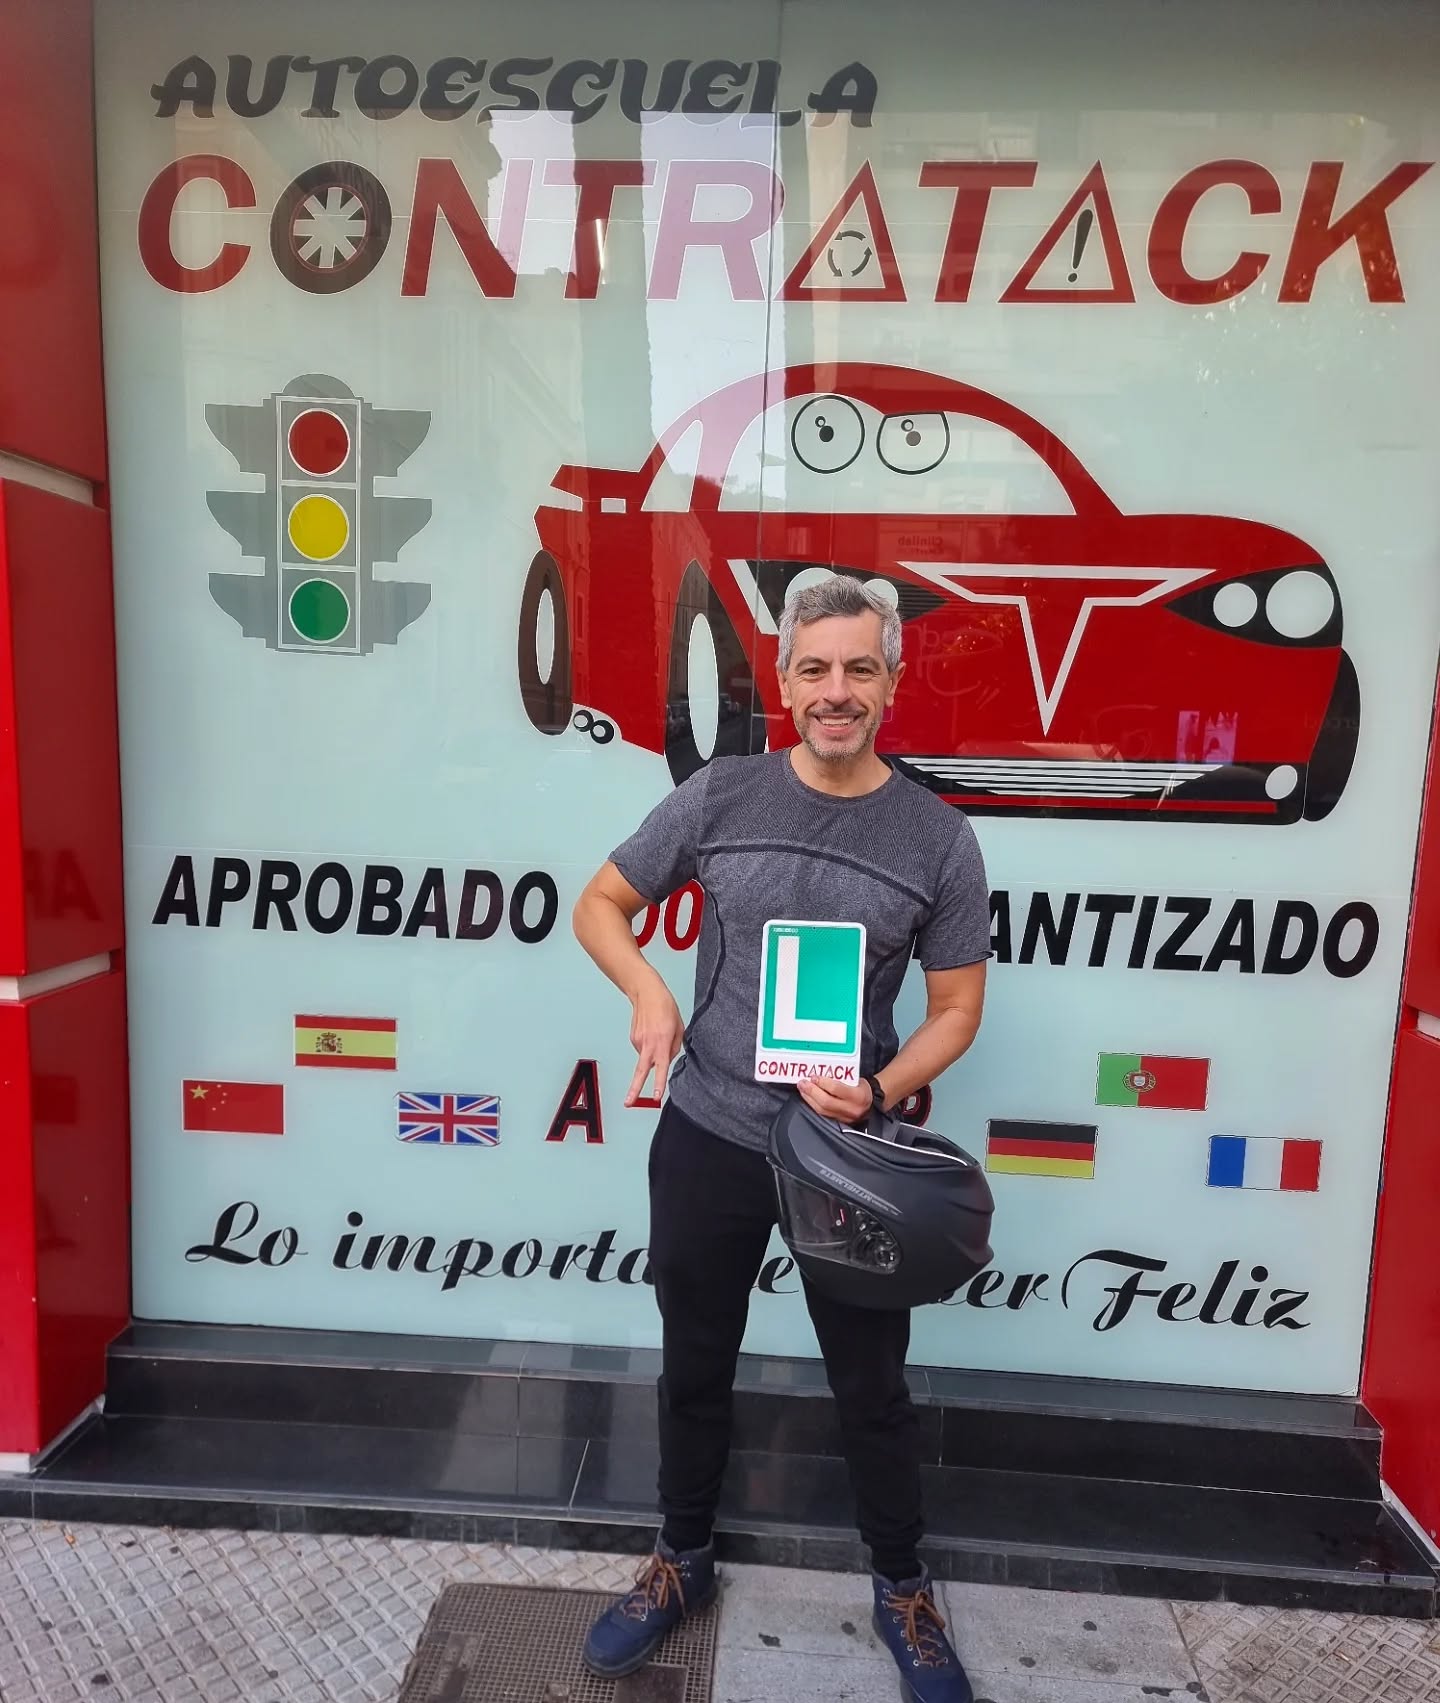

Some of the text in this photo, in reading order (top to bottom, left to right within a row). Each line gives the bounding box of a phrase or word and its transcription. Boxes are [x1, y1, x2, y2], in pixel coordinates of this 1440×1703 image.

[149, 54, 878, 127] AUTOESCUELA
[137, 152, 1437, 305] CONTRATACK
[151, 855, 560, 944] APROBADO
[988, 890, 1380, 979] ANTIZADO
[772, 935, 848, 1044] L
[544, 1058, 605, 1145] A
[757, 1060, 856, 1081] CONTRATACK
[184, 1200, 308, 1268] Lo
[938, 1270, 1050, 1310] er
[1061, 1249, 1311, 1332] Feliz
